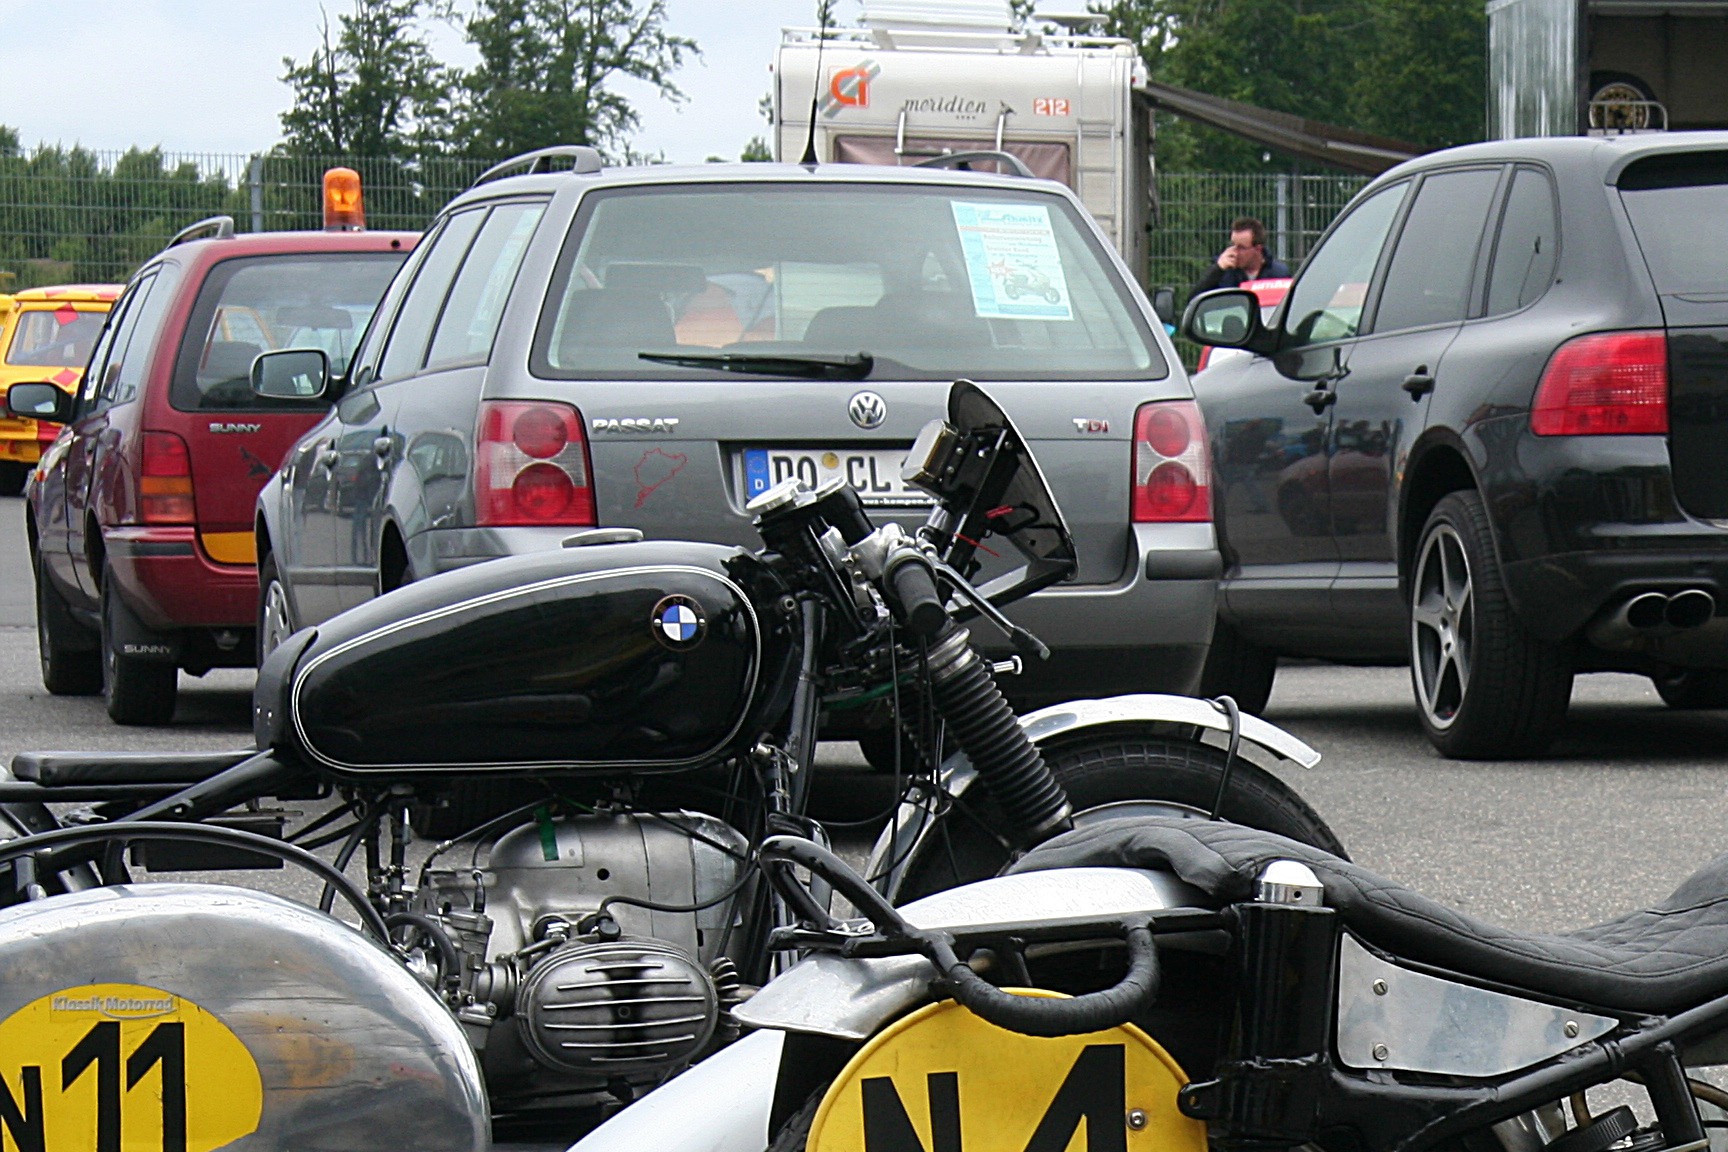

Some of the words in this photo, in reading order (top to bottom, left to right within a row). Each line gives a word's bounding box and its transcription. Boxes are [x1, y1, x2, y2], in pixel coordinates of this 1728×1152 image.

[1035, 99, 1069, 116] 212
[209, 422, 261, 432] SUNNY
[592, 418, 679, 433] PASSAT
[1072, 418, 1109, 432] TDI
[846, 455, 892, 493] CL
[54, 996, 103, 1011] Klassik
[105, 994, 174, 1012] Motorrad
